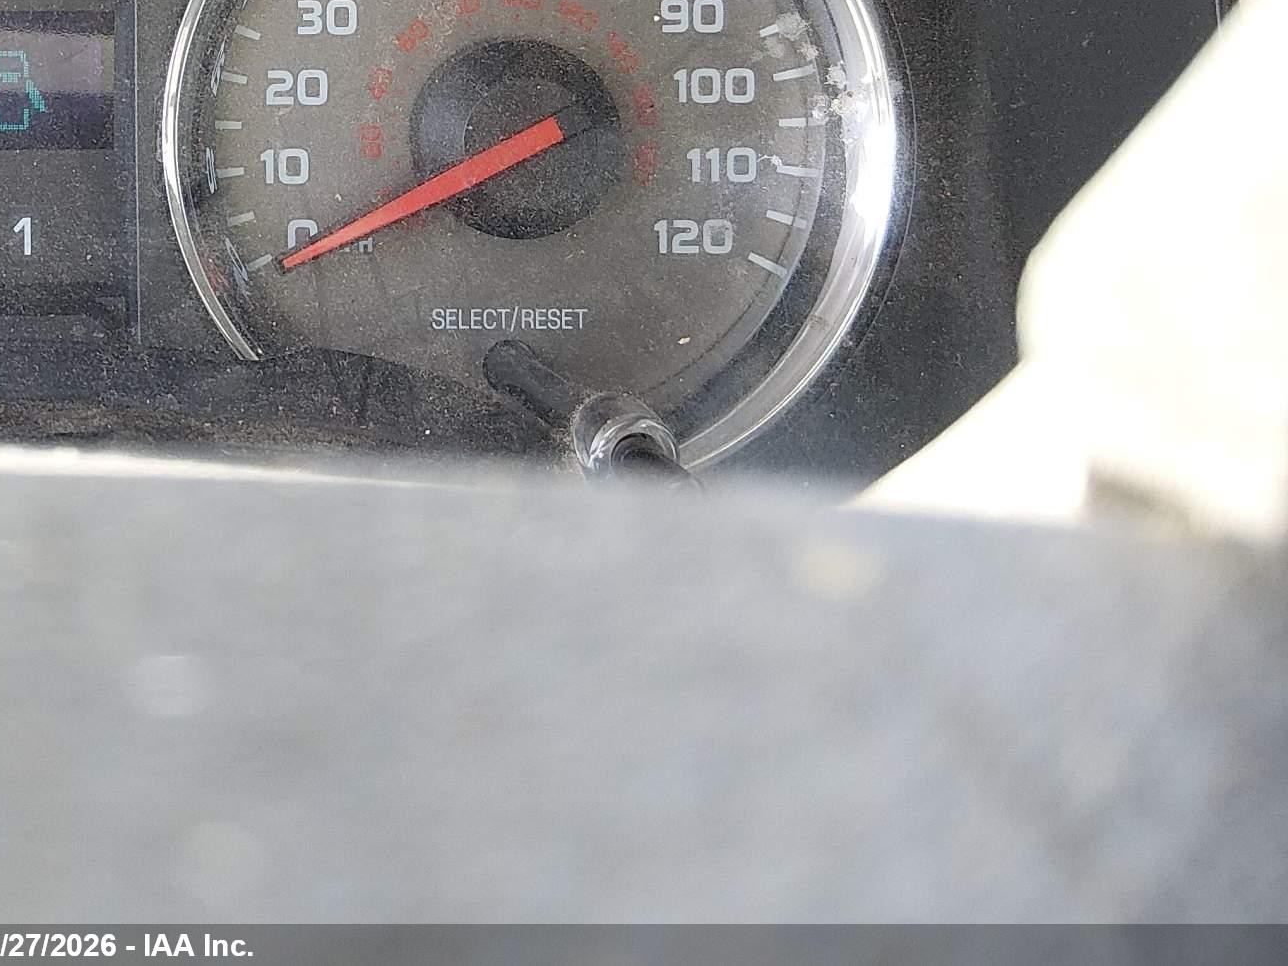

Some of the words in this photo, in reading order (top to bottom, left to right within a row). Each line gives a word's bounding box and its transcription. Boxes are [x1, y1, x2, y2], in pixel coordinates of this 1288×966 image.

[266, 69, 328, 106] 20
[673, 68, 755, 103] 100
[260, 148, 309, 185] 10
[686, 147, 757, 183] 110
[13, 217, 32, 256] 1
[653, 218, 733, 254] 120
[431, 306, 589, 332] SELECT/RESET
